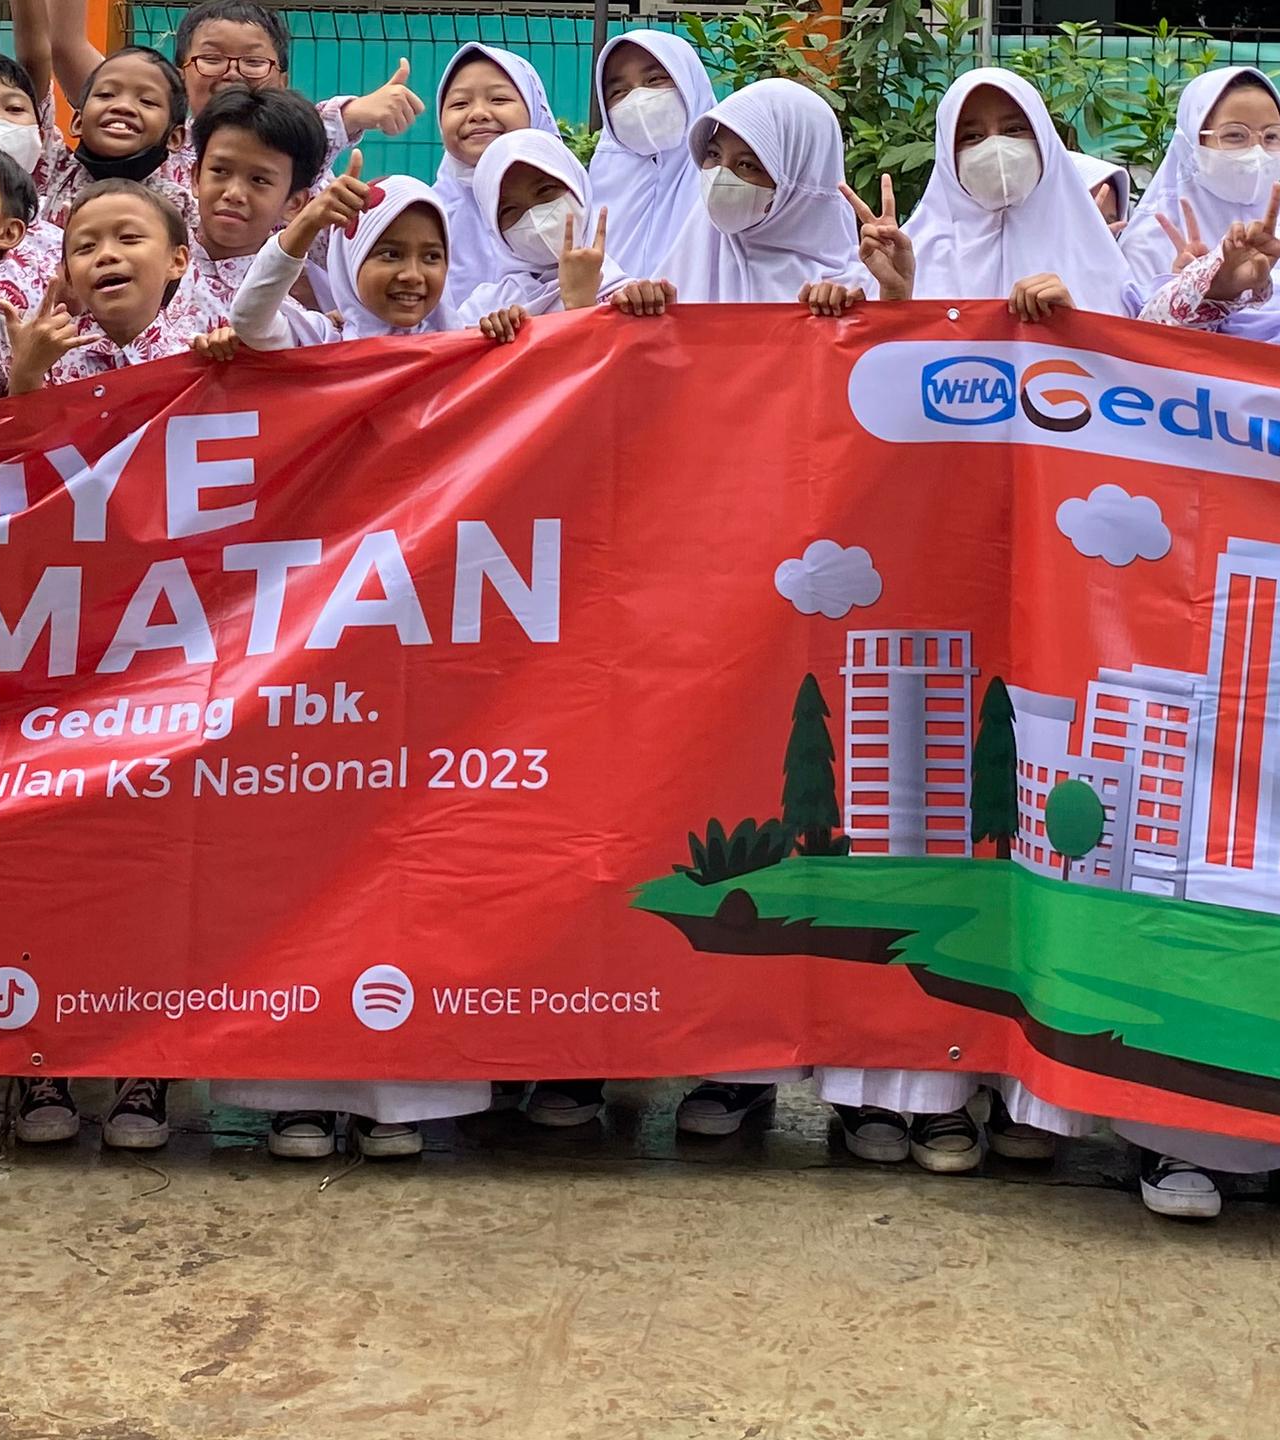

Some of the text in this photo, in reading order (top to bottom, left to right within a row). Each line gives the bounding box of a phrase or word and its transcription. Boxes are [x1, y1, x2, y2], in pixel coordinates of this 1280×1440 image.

[20, 696, 234, 740] Gedung
[258, 682, 381, 725] Tbk.
[106, 758, 172, 799] K3
[193, 747, 407, 797] Nasional
[428, 748, 549, 791] 2023
[55, 984, 320, 1021] ptwikagedungID
[432, 985, 661, 1015] WEGE Podcast
